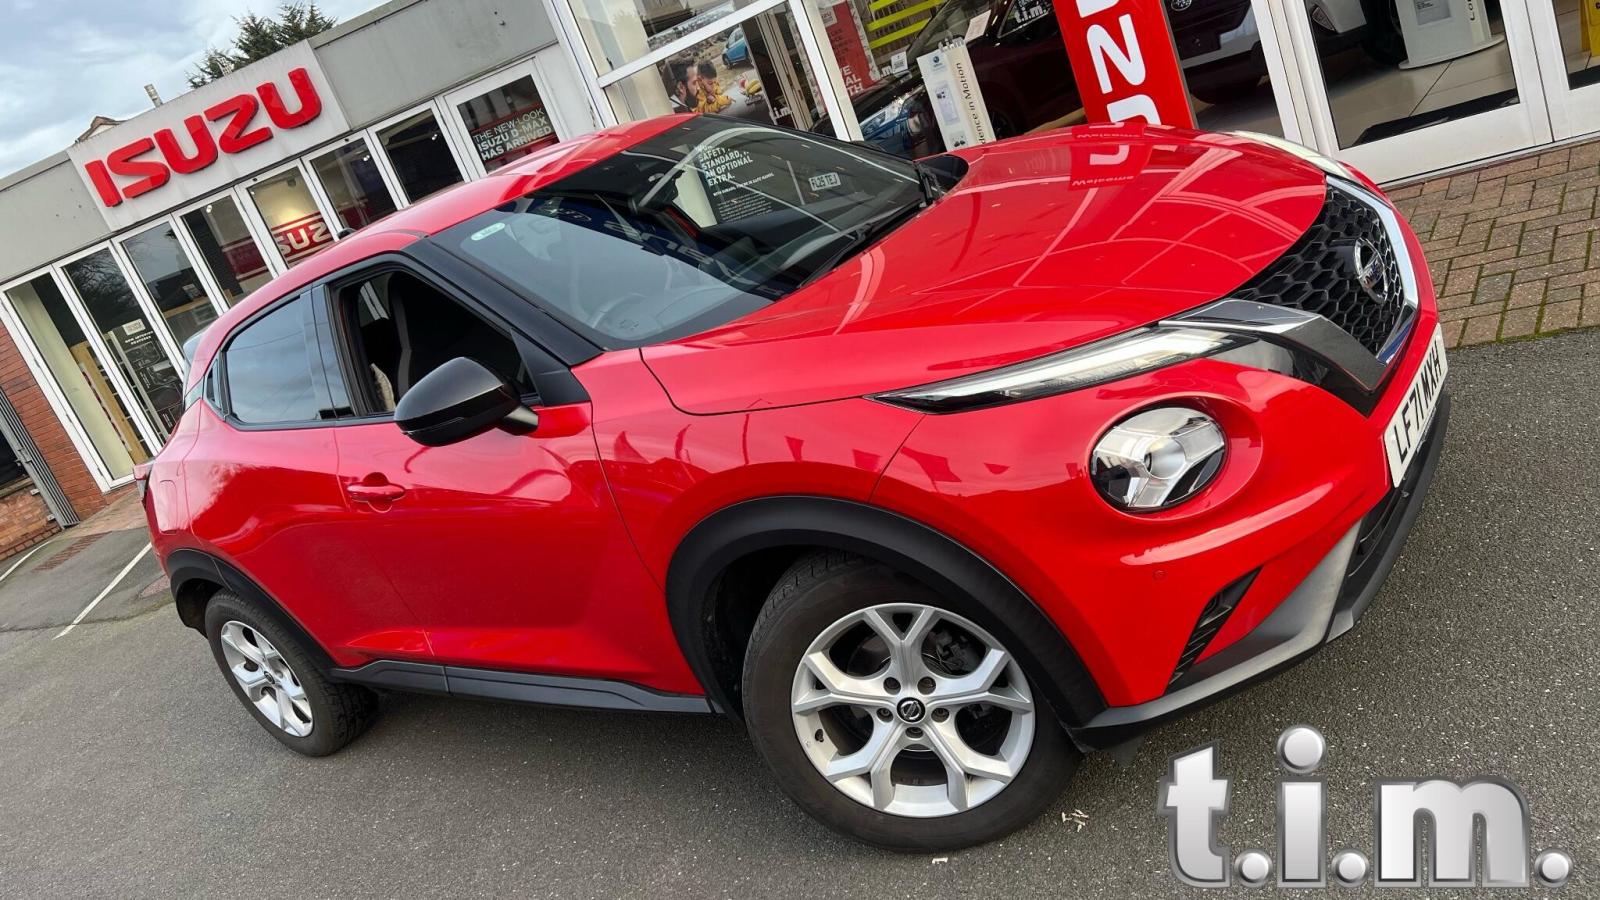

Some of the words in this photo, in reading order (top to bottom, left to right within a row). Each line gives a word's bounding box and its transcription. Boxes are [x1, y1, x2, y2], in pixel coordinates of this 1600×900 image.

[956, 62, 973, 101] Motion
[84, 68, 322, 208] ISUZU
[473, 129, 494, 142] THE
[494, 107, 545, 134] NEW-LOOK
[477, 133, 510, 152] ISUZU
[510, 116, 548, 138] D-MAX
[481, 146, 504, 161] HAS
[506, 125, 552, 152] ARRIVED
[704, 167, 717, 179] AN
[716, 156, 754, 176] OPTIONAL
[708, 172, 735, 187] EXTRA.
[1394, 383, 1424, 463] LF71
[1421, 341, 1442, 408] MXH
